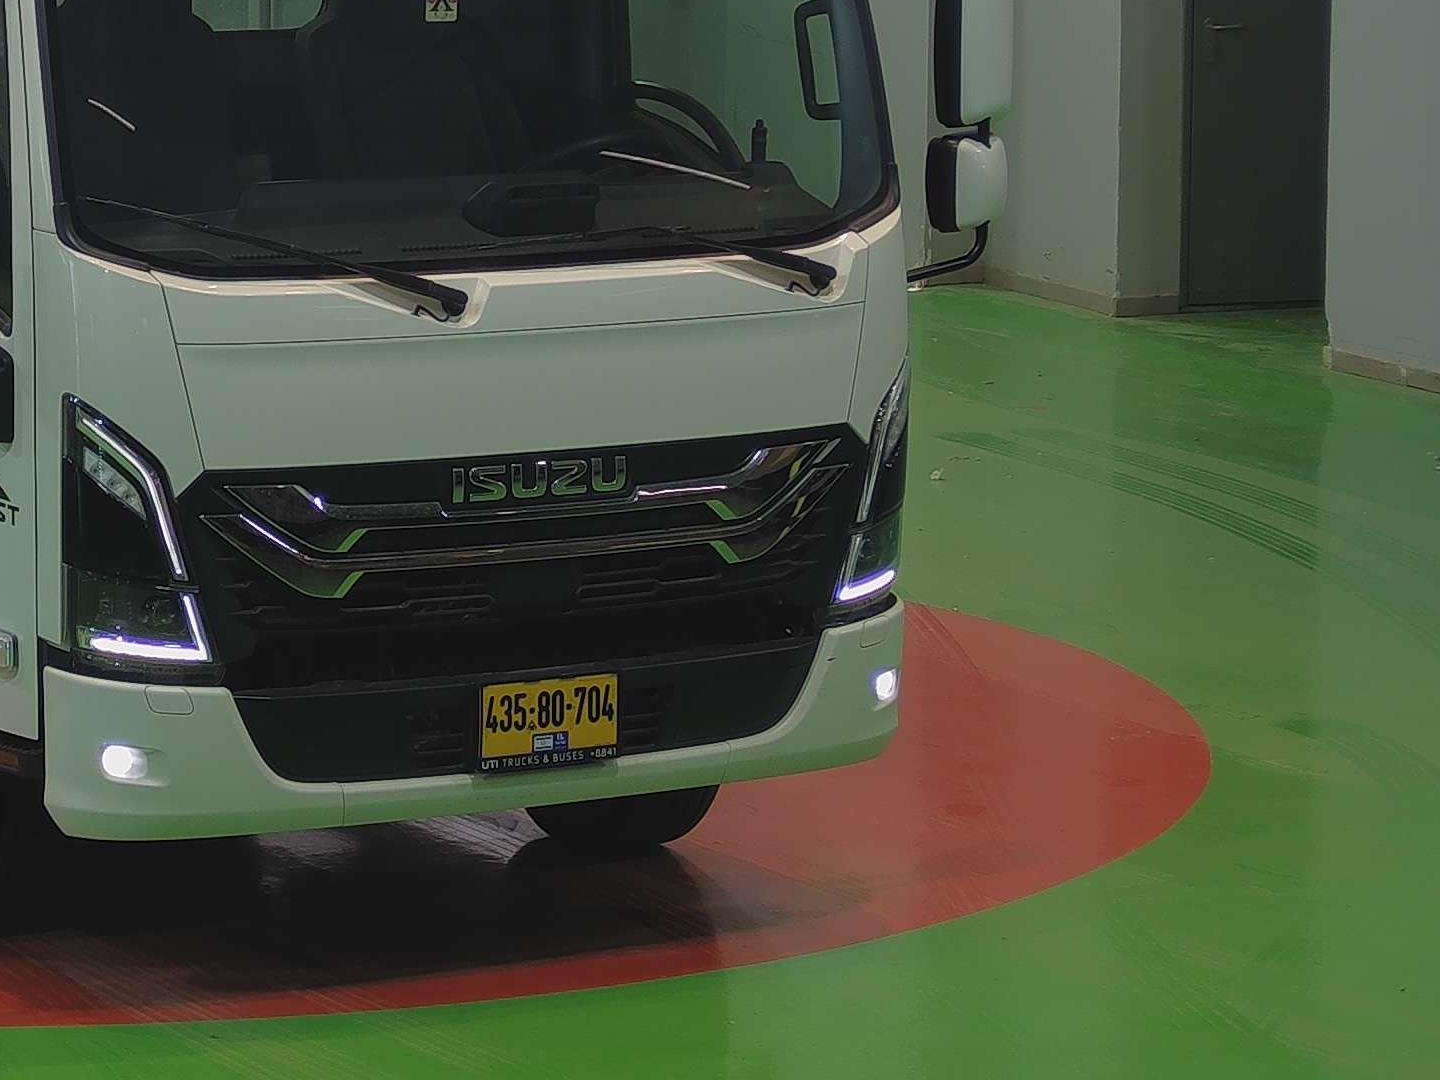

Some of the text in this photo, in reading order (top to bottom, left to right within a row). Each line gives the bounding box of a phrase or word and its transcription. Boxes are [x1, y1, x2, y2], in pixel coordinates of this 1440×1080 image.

[452, 455, 627, 504] ISUZU
[502, 754, 540, 768] TRUCKS
[542, 753, 550, 764] &
[553, 750, 585, 762] BUSES
